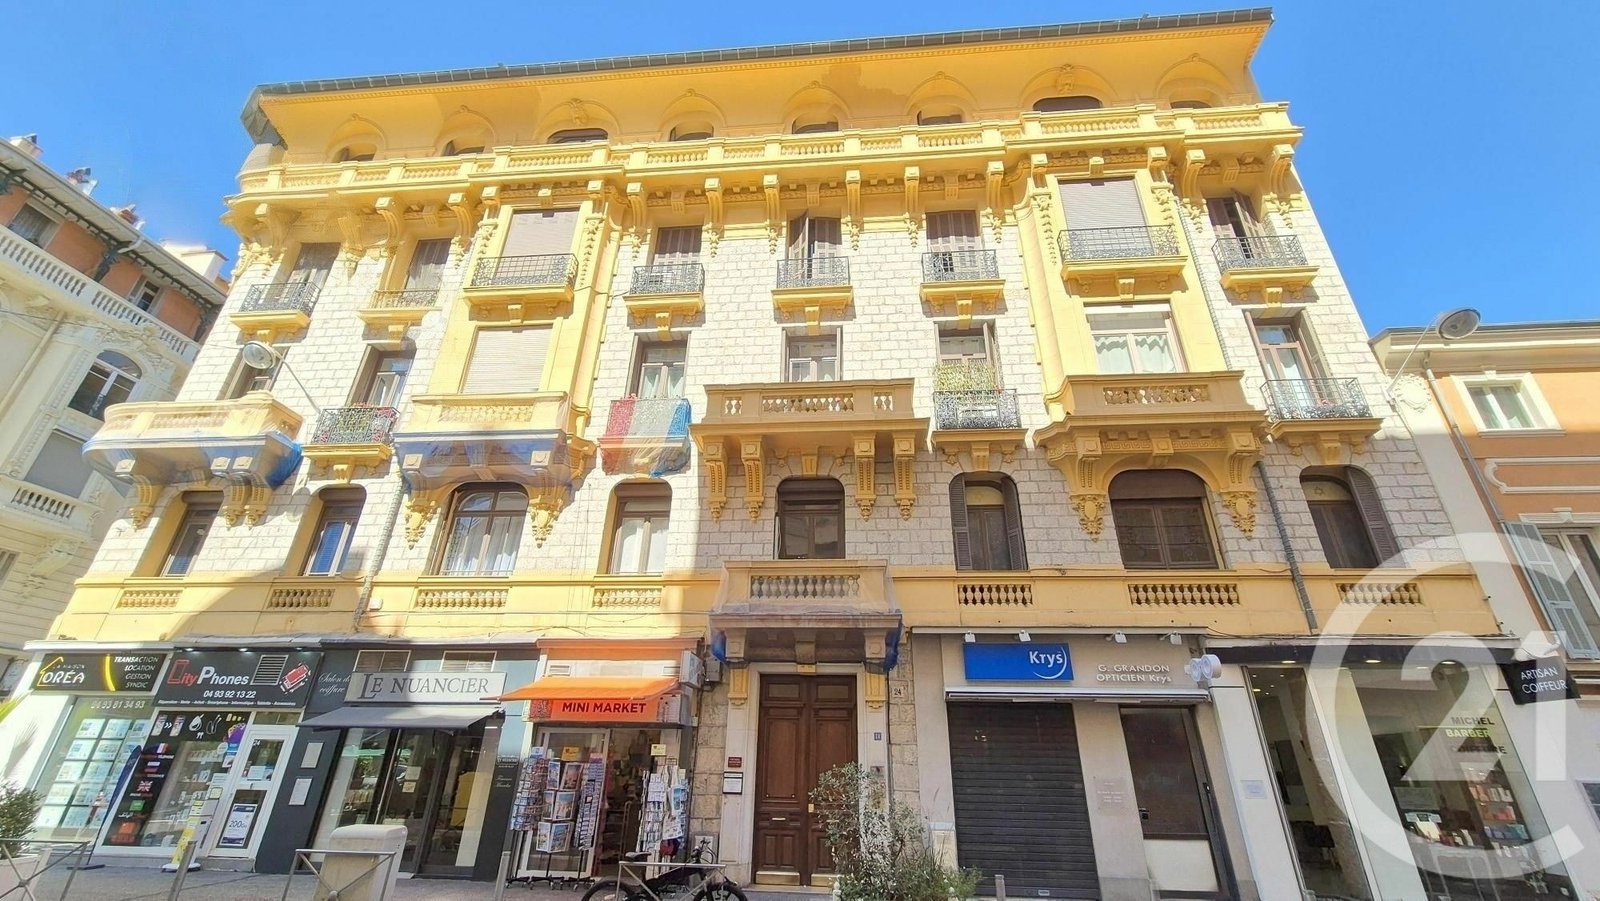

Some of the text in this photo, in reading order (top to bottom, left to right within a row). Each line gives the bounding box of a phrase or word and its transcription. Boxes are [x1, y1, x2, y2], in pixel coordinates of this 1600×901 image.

[1029, 650, 1063, 668] Krys
[1098, 664, 1170, 672] G. GRANDON
[1521, 666, 1558, 680] ARTISAN
[318, 672, 341, 683] Salon
[1096, 674, 1172, 684] OPTICIEN Krys
[319, 684, 345, 696] coiffure
[357, 673, 489, 700] LE NUANCIER
[894, 688, 902, 696] 24
[1522, 680, 1568, 693] COIFFEUR
[203, 690, 257, 699] 04 93 92 13 22
[102, 701, 112, 709] 93
[123, 701, 134, 709] 34
[134, 701, 145, 709] 93
[562, 702, 646, 713] MINI MARKET
[1451, 717, 1495, 725] MICHEL
